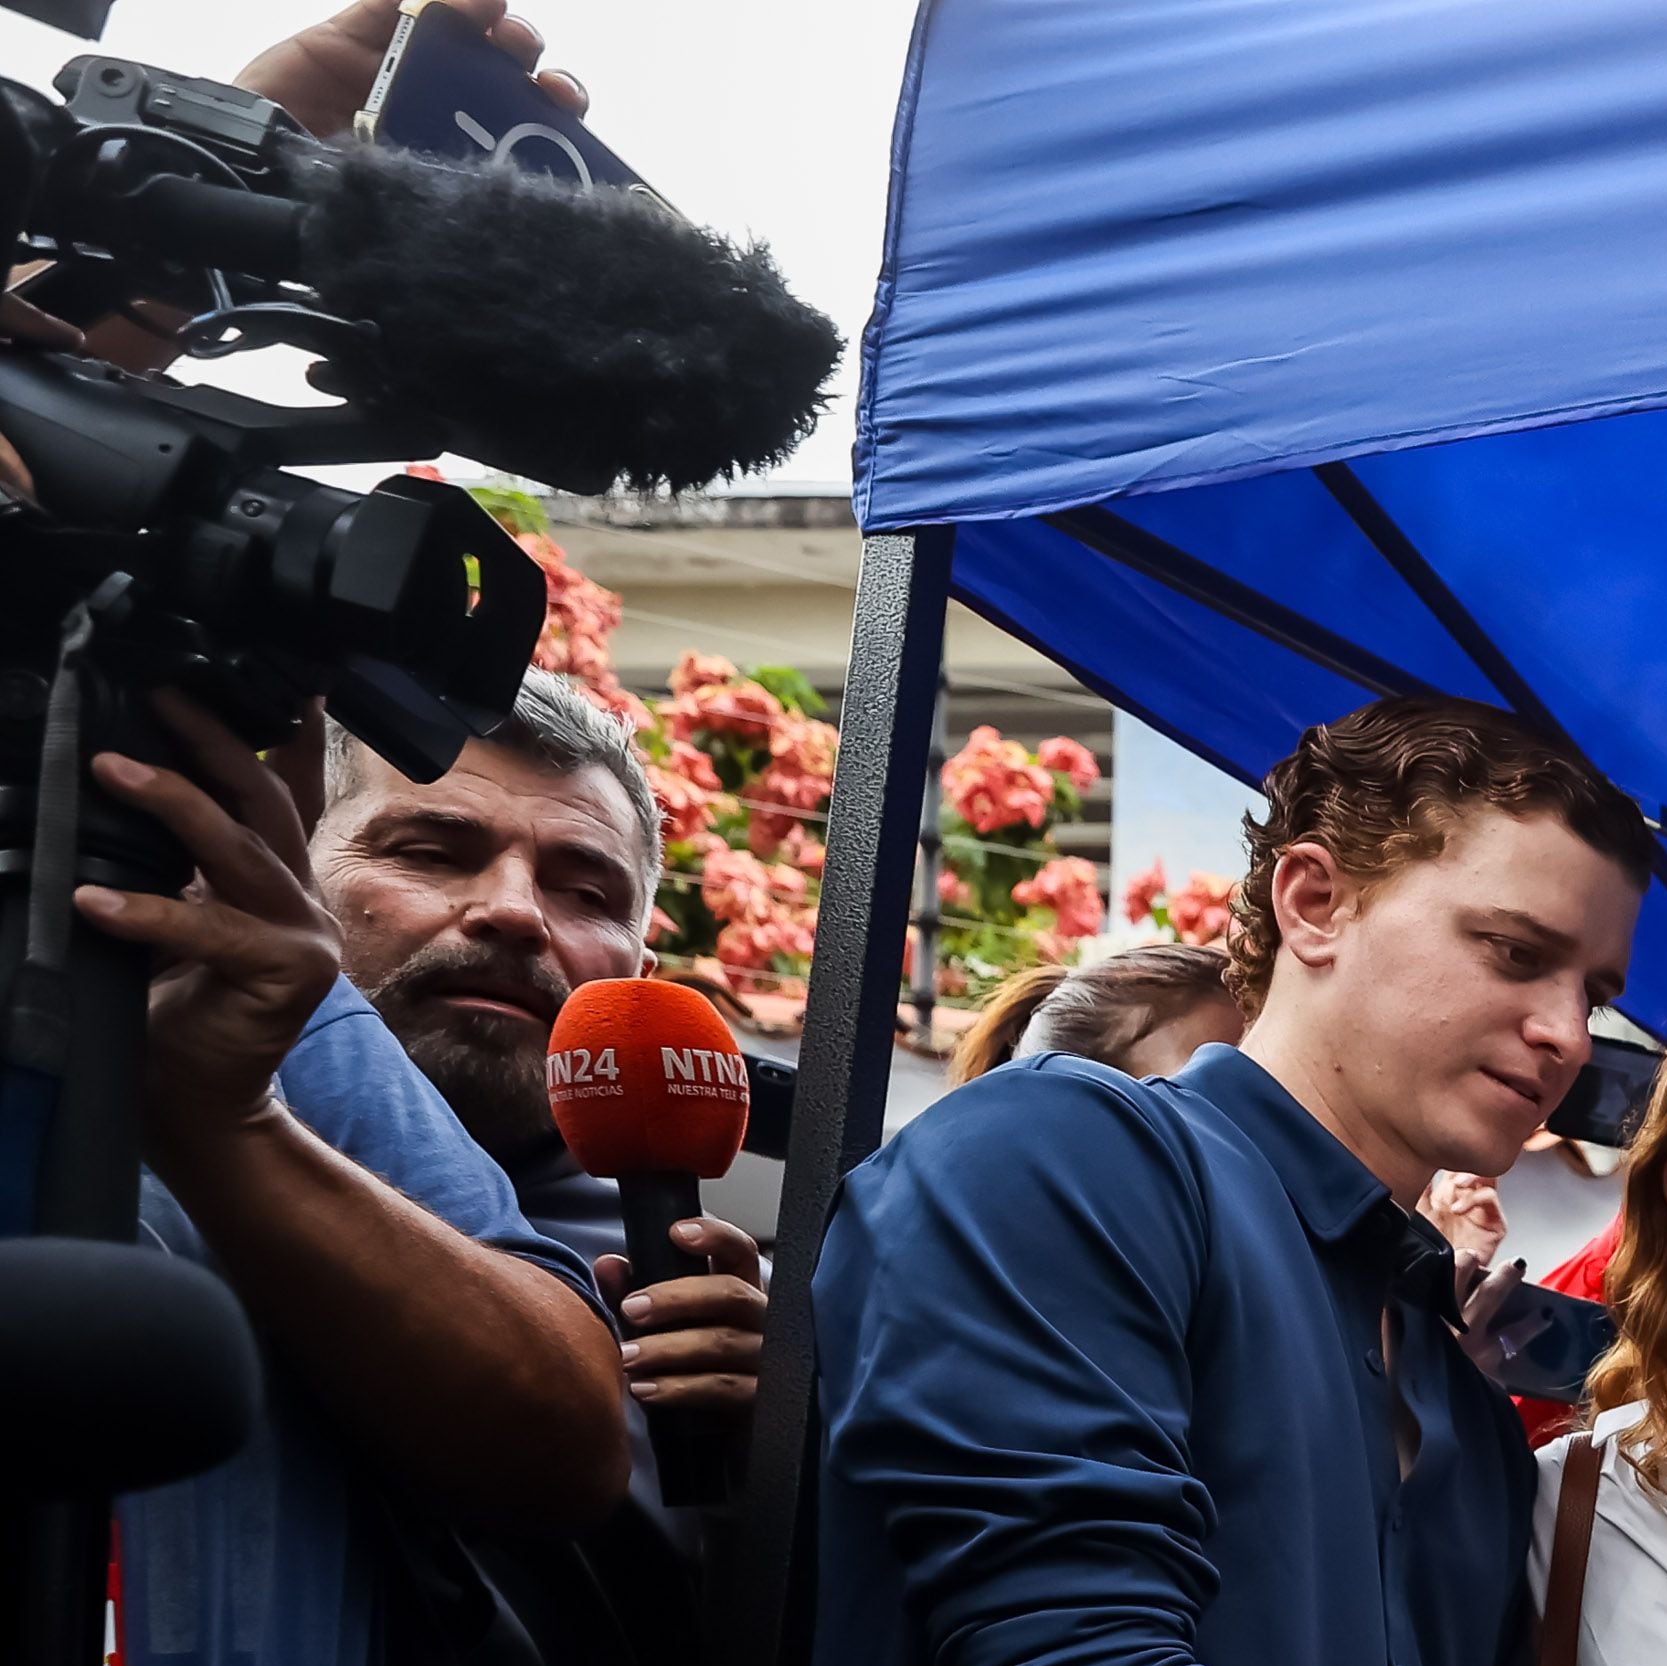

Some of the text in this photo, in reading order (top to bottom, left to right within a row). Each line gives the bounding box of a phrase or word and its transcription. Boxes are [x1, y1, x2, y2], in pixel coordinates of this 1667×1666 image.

[546, 1048, 620, 1088] TN24
[660, 1047, 749, 1087] NTN2
[575, 1085, 624, 1098] NOTICIAS
[667, 1084, 717, 1098] NUESTRA
[719, 1088, 737, 1101] TELE
